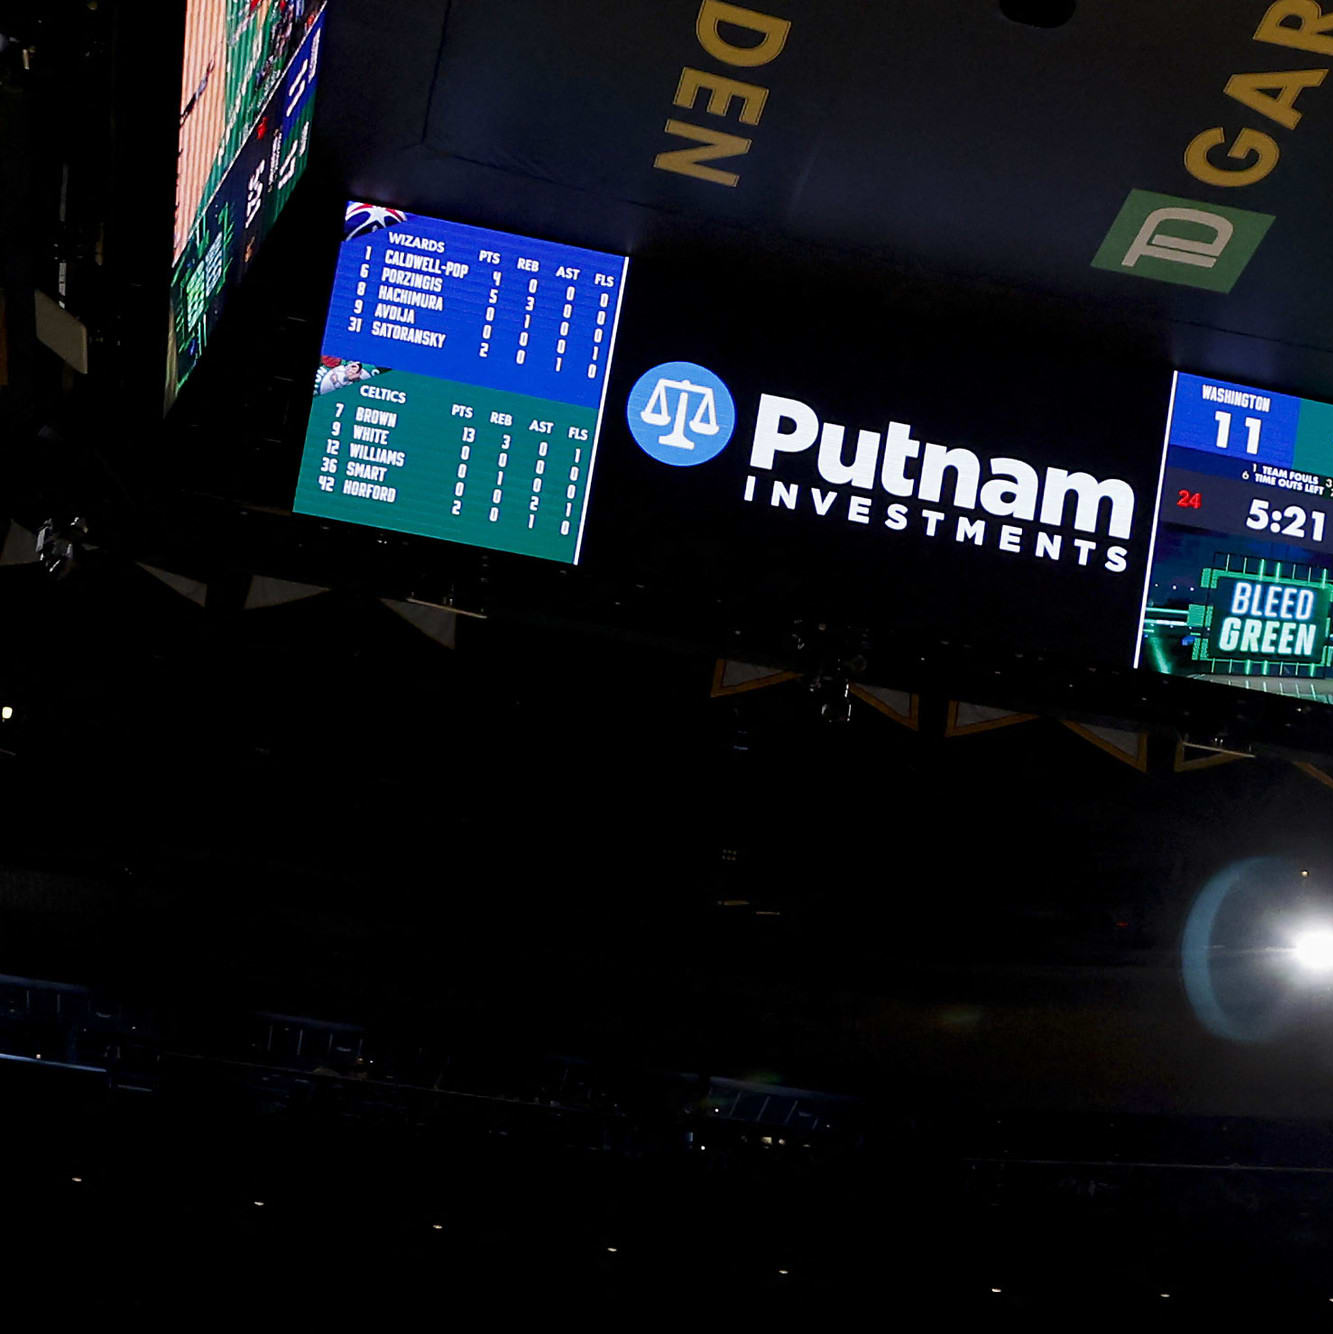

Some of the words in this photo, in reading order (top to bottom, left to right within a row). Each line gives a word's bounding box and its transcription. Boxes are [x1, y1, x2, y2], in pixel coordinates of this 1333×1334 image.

[652, 0, 791, 188] DEN
[1122, 205, 1234, 268] TD
[365, 245, 372, 261] 1
[384, 249, 469, 280] CALDWELL-POP
[492, 271, 502, 287] 4
[388, 231, 445, 253] WIZARDS
[478, 249, 501, 265] PTS
[516, 257, 540, 273] REB
[555, 265, 581, 281] AST
[594, 272, 615, 288] FLS
[356, 281, 366, 297] 8
[377, 284, 443, 312] HACHIMURA
[485, 307, 495, 322] 0
[359, 264, 369, 279] 6
[381, 267, 443, 293] PORZINGIS
[489, 289, 499, 304] 5
[347, 316, 363, 333] 31
[371, 320, 447, 349] SATORANSKY
[479, 342, 489, 358] 2
[353, 299, 363, 315] 9
[374, 303, 415, 324] AVDIJA
[482, 324, 492, 340] 0
[359, 384, 407, 404] CELTICS
[451, 403, 474, 419] PTS
[489, 411, 513, 427] REB
[528, 419, 555, 434] AST
[568, 426, 589, 441] FLS
[1202, 384, 1271, 413] WASHINGTON
[331, 421, 341, 436] 9
[353, 424, 390, 445] WHITE
[460, 445, 471, 461] 0
[335, 402, 345, 418] 7
[355, 406, 398, 428] BROWN
[461, 426, 476, 443] 13
[1214, 410, 1262, 455] 11
[320, 456, 338, 474] 36
[345, 461, 388, 482] SMART
[454, 481, 465, 497] 0
[326, 438, 341, 456] 12
[349, 442, 406, 467] WILLIAMS
[457, 463, 467, 479] 0
[749, 392, 1135, 541] Putnam
[1262, 466, 1288, 479] TEAM
[1289, 471, 1320, 486] FOULS
[1326, 479, 1332, 488] 3
[318, 474, 335, 492] 42
[342, 479, 397, 503] HORFORD
[451, 499, 462, 516] 2
[1242, 471, 1249, 480] 6
[1255, 473, 1277, 487] TIME
[1278, 478, 1302, 491] OUTS
[1304, 483, 1326, 496] LEFT
[744, 475, 1128, 572] INVESTMENTS
[1177, 489, 1202, 509] 24
[1246, 499, 1326, 541] 5:21
[1231, 582, 1314, 620] BLEED
[1218, 617, 1316, 656] GREEN
